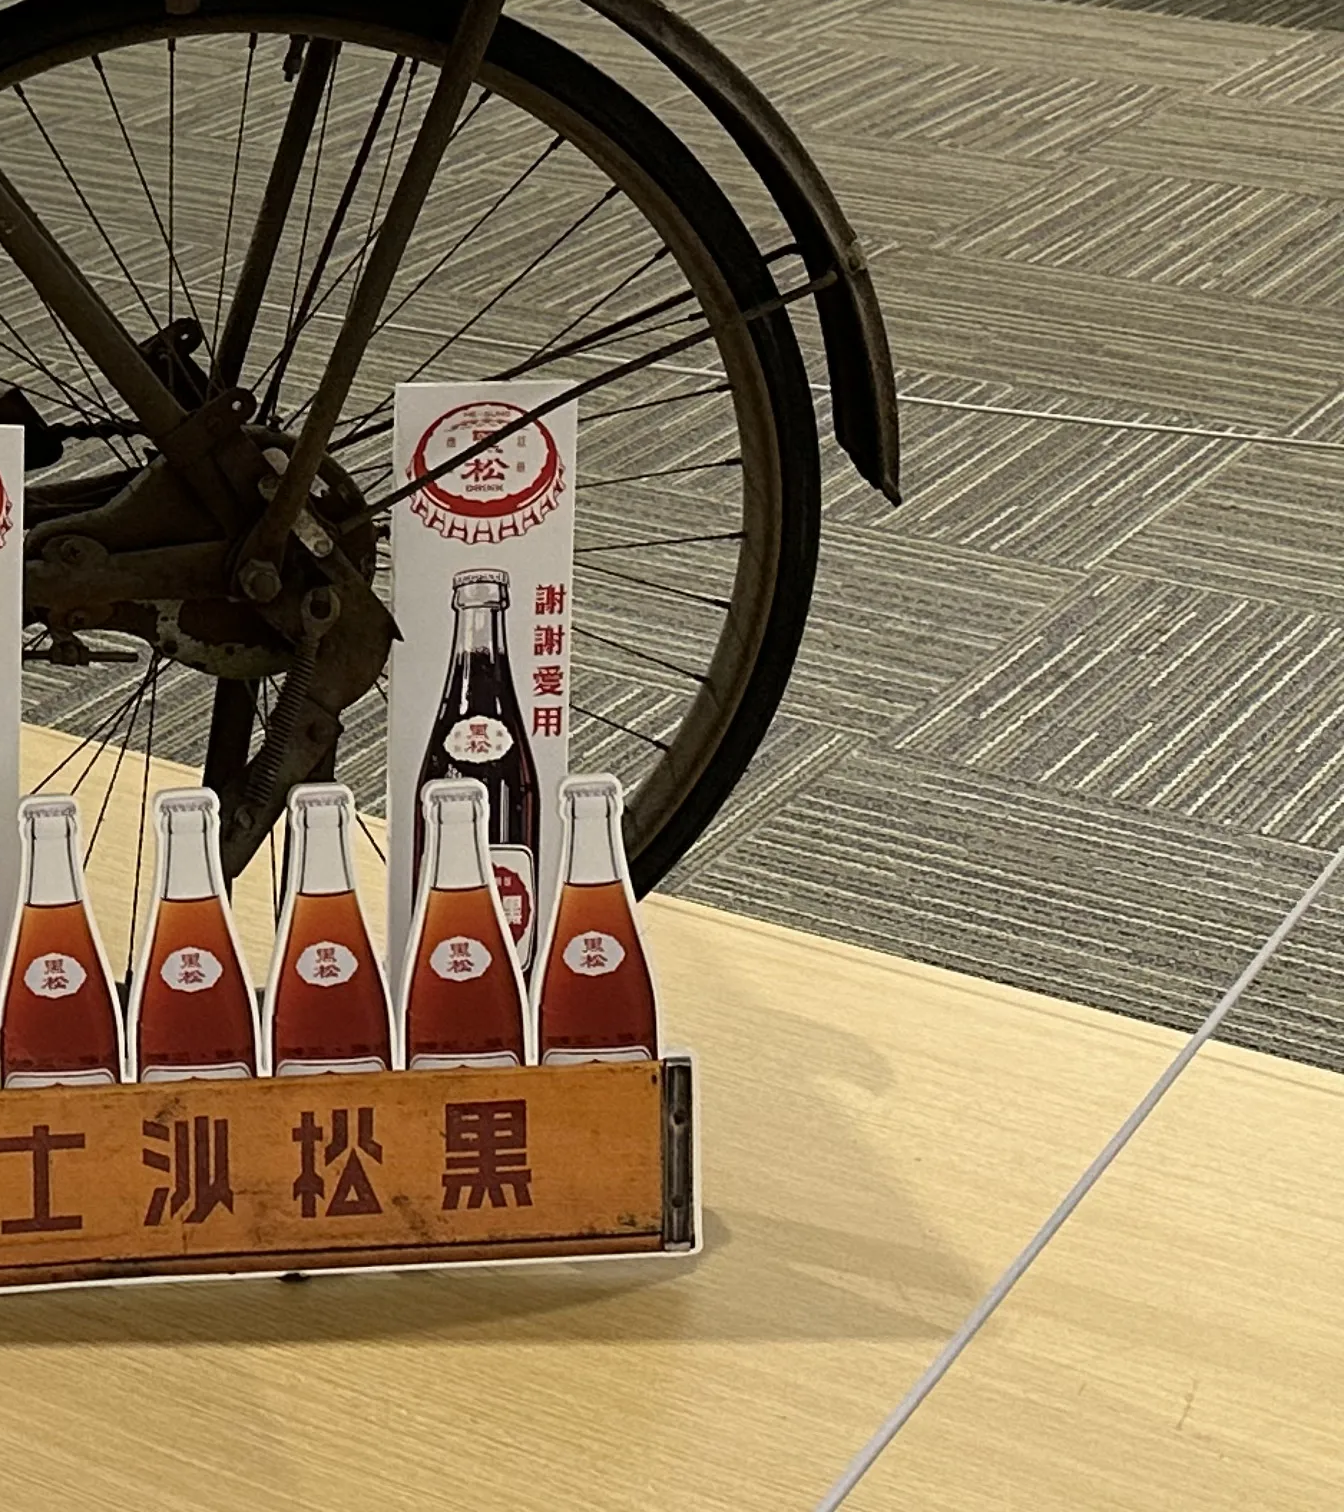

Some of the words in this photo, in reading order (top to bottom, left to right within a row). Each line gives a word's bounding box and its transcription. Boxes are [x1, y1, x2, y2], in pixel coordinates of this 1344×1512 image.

[531, 583, 567, 737] 謝謝愛用
[465, 723, 492, 754] 黑松
[178, 953, 206, 985] 黑松
[313, 947, 341, 979] 黑松
[446, 941, 475, 974] 黑松
[579, 937, 608, 969] 黑松
[41, 958, 68, 990] 黑松
